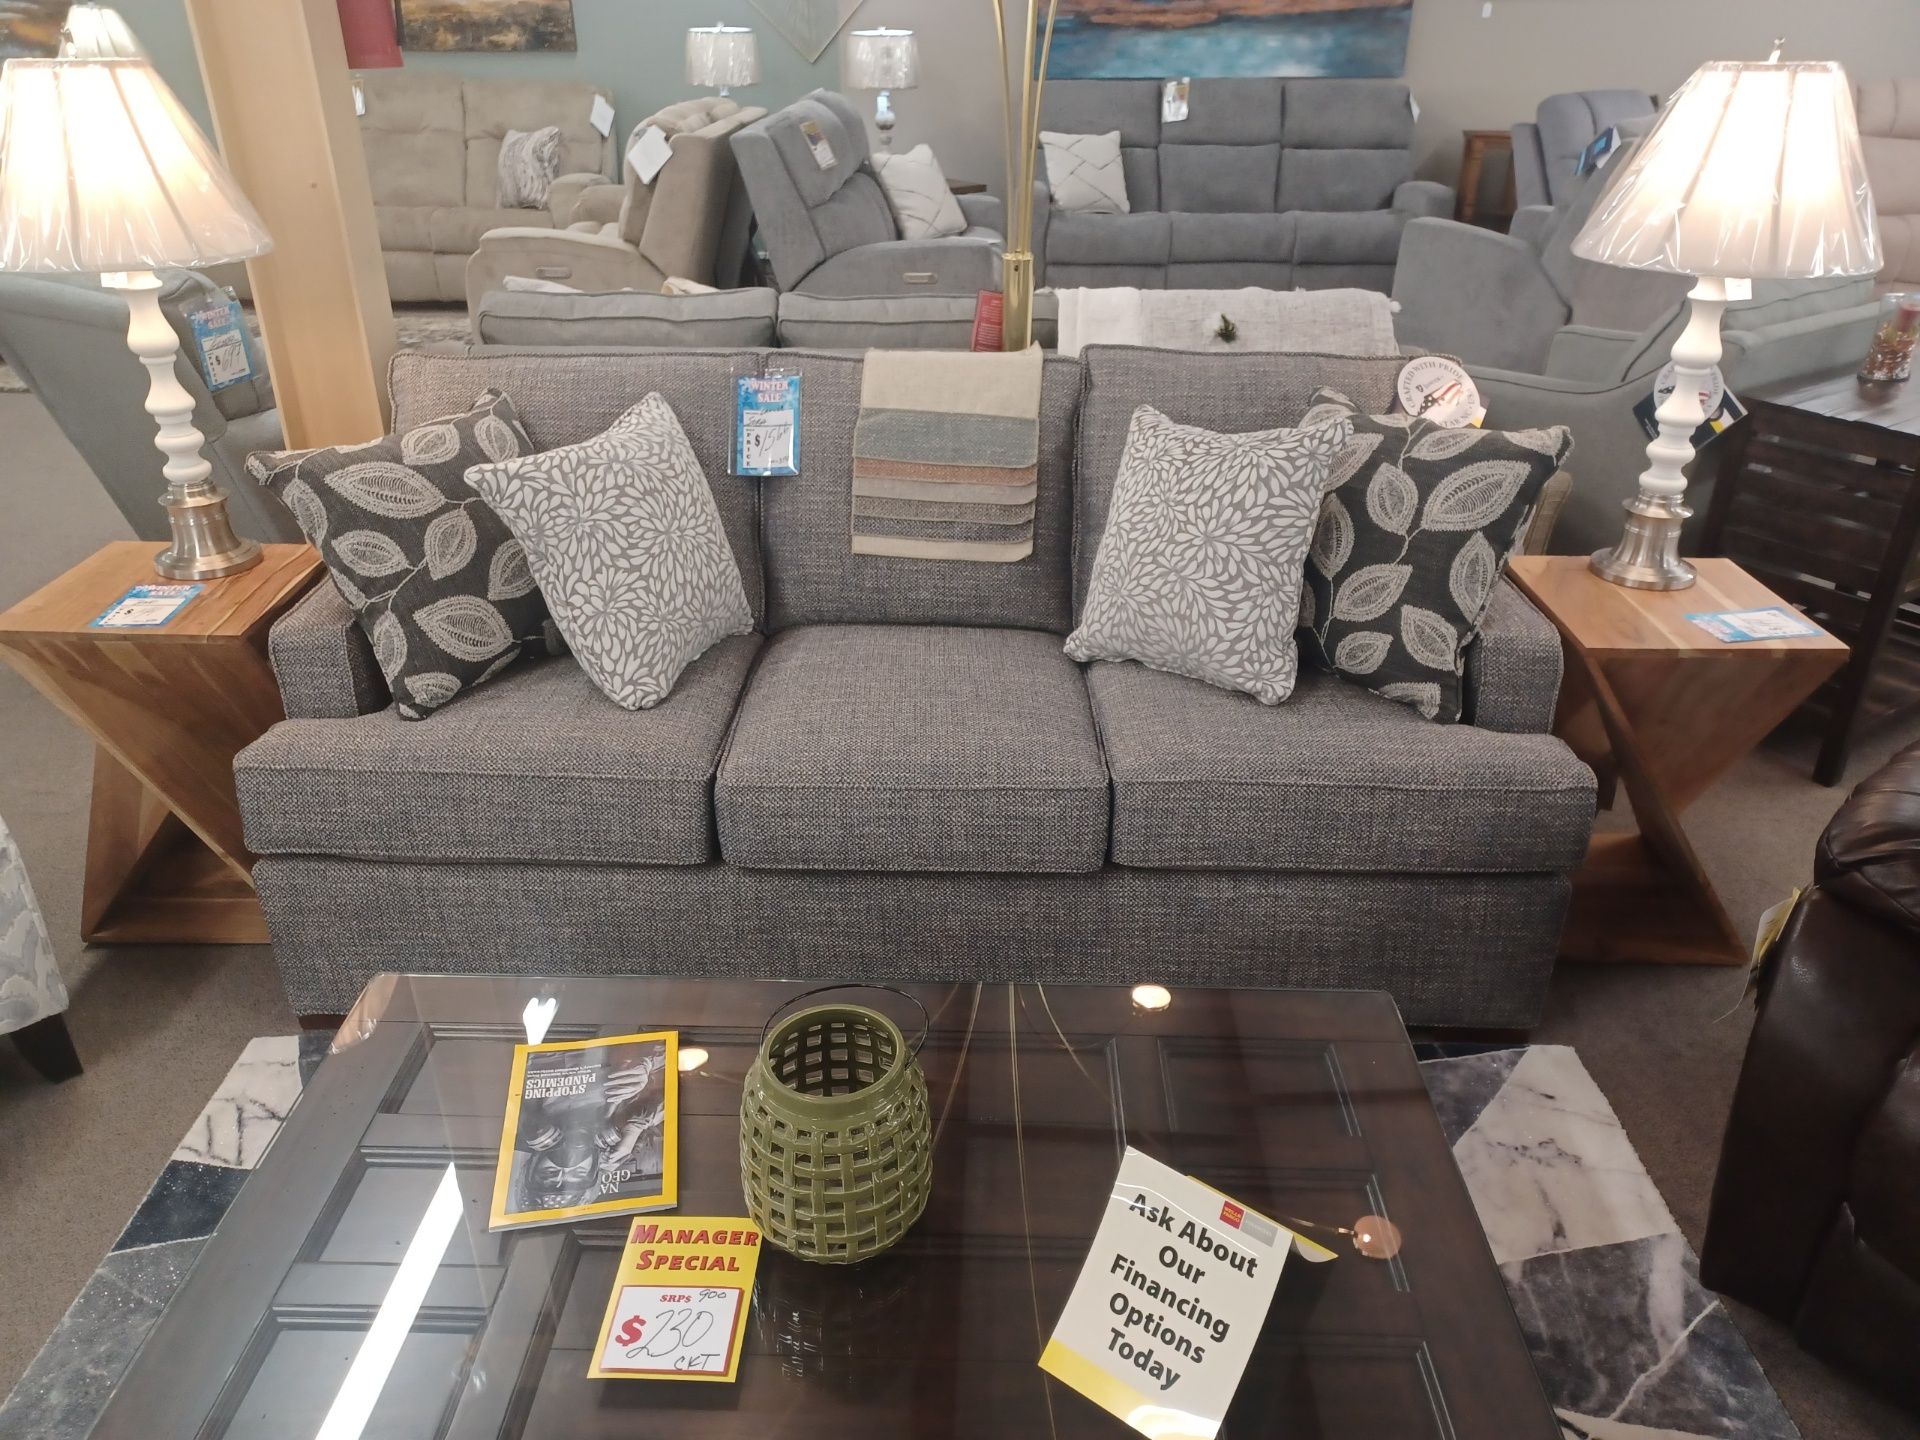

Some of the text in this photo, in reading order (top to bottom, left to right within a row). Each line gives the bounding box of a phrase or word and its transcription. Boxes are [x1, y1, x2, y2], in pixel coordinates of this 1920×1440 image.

[750, 380, 789, 391] WINTER
[758, 392, 783, 402] SALE
[525, 1084, 586, 1100] STOPPING
[526, 1073, 596, 1089] PANDEMICS
[631, 1224, 760, 1247] MANAGER
[1129, 1193, 1258, 1279] Ask About
[635, 1250, 741, 1272] SPECIAL
[1158, 1245, 1206, 1285] Our
[1110, 1254, 1231, 1343] Financing
[1109, 1292, 1206, 1365] Options
[1107, 1327, 1182, 1391] Today
